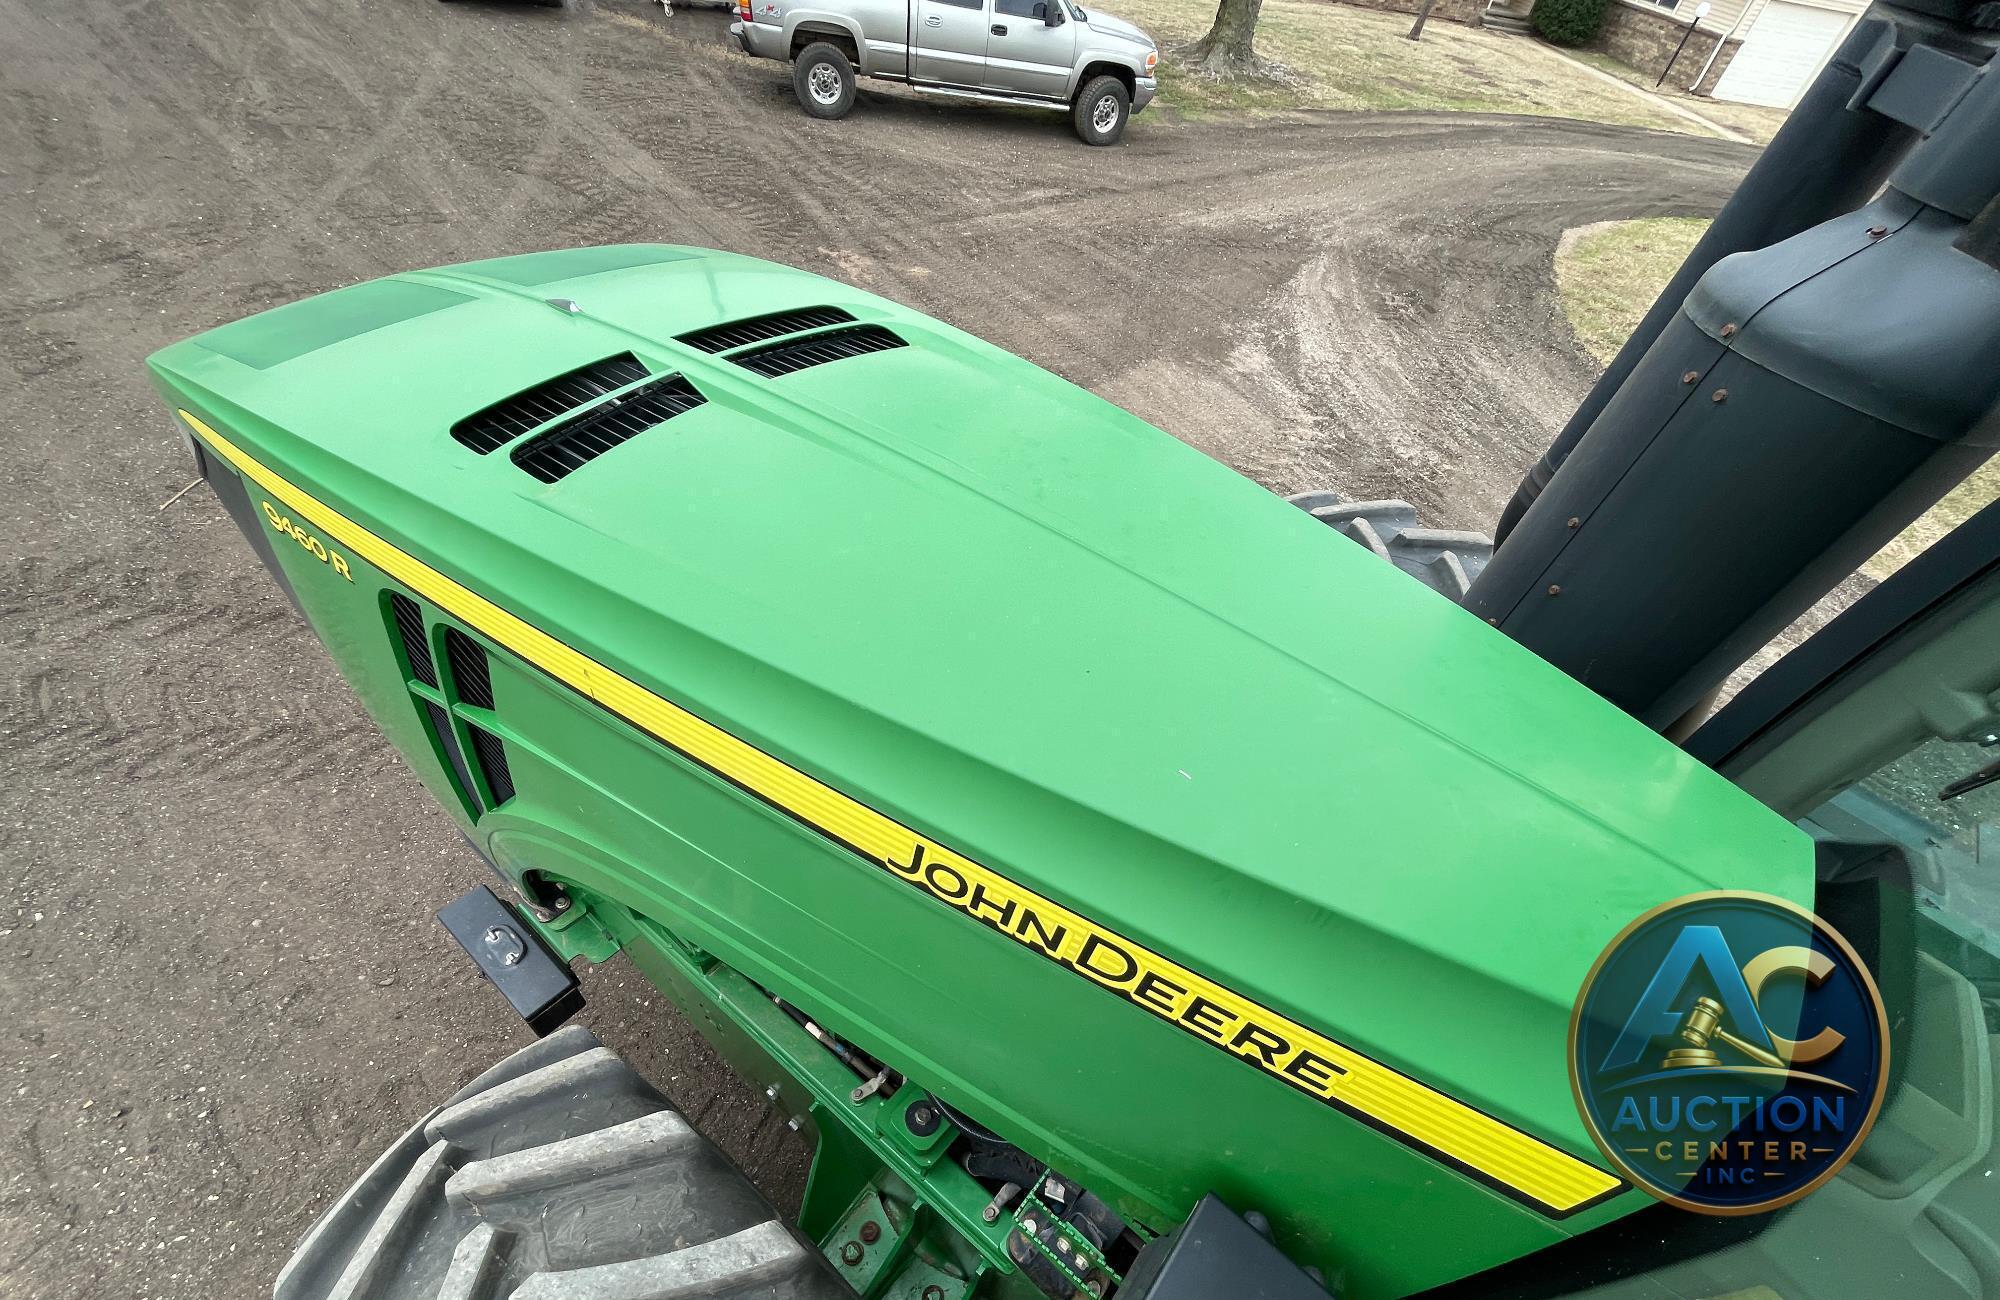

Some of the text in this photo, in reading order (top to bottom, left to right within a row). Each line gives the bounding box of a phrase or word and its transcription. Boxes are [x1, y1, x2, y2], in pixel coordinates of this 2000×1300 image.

[262, 500, 329, 563] 9460
[887, 843, 1351, 1095] JOHN DEERE
